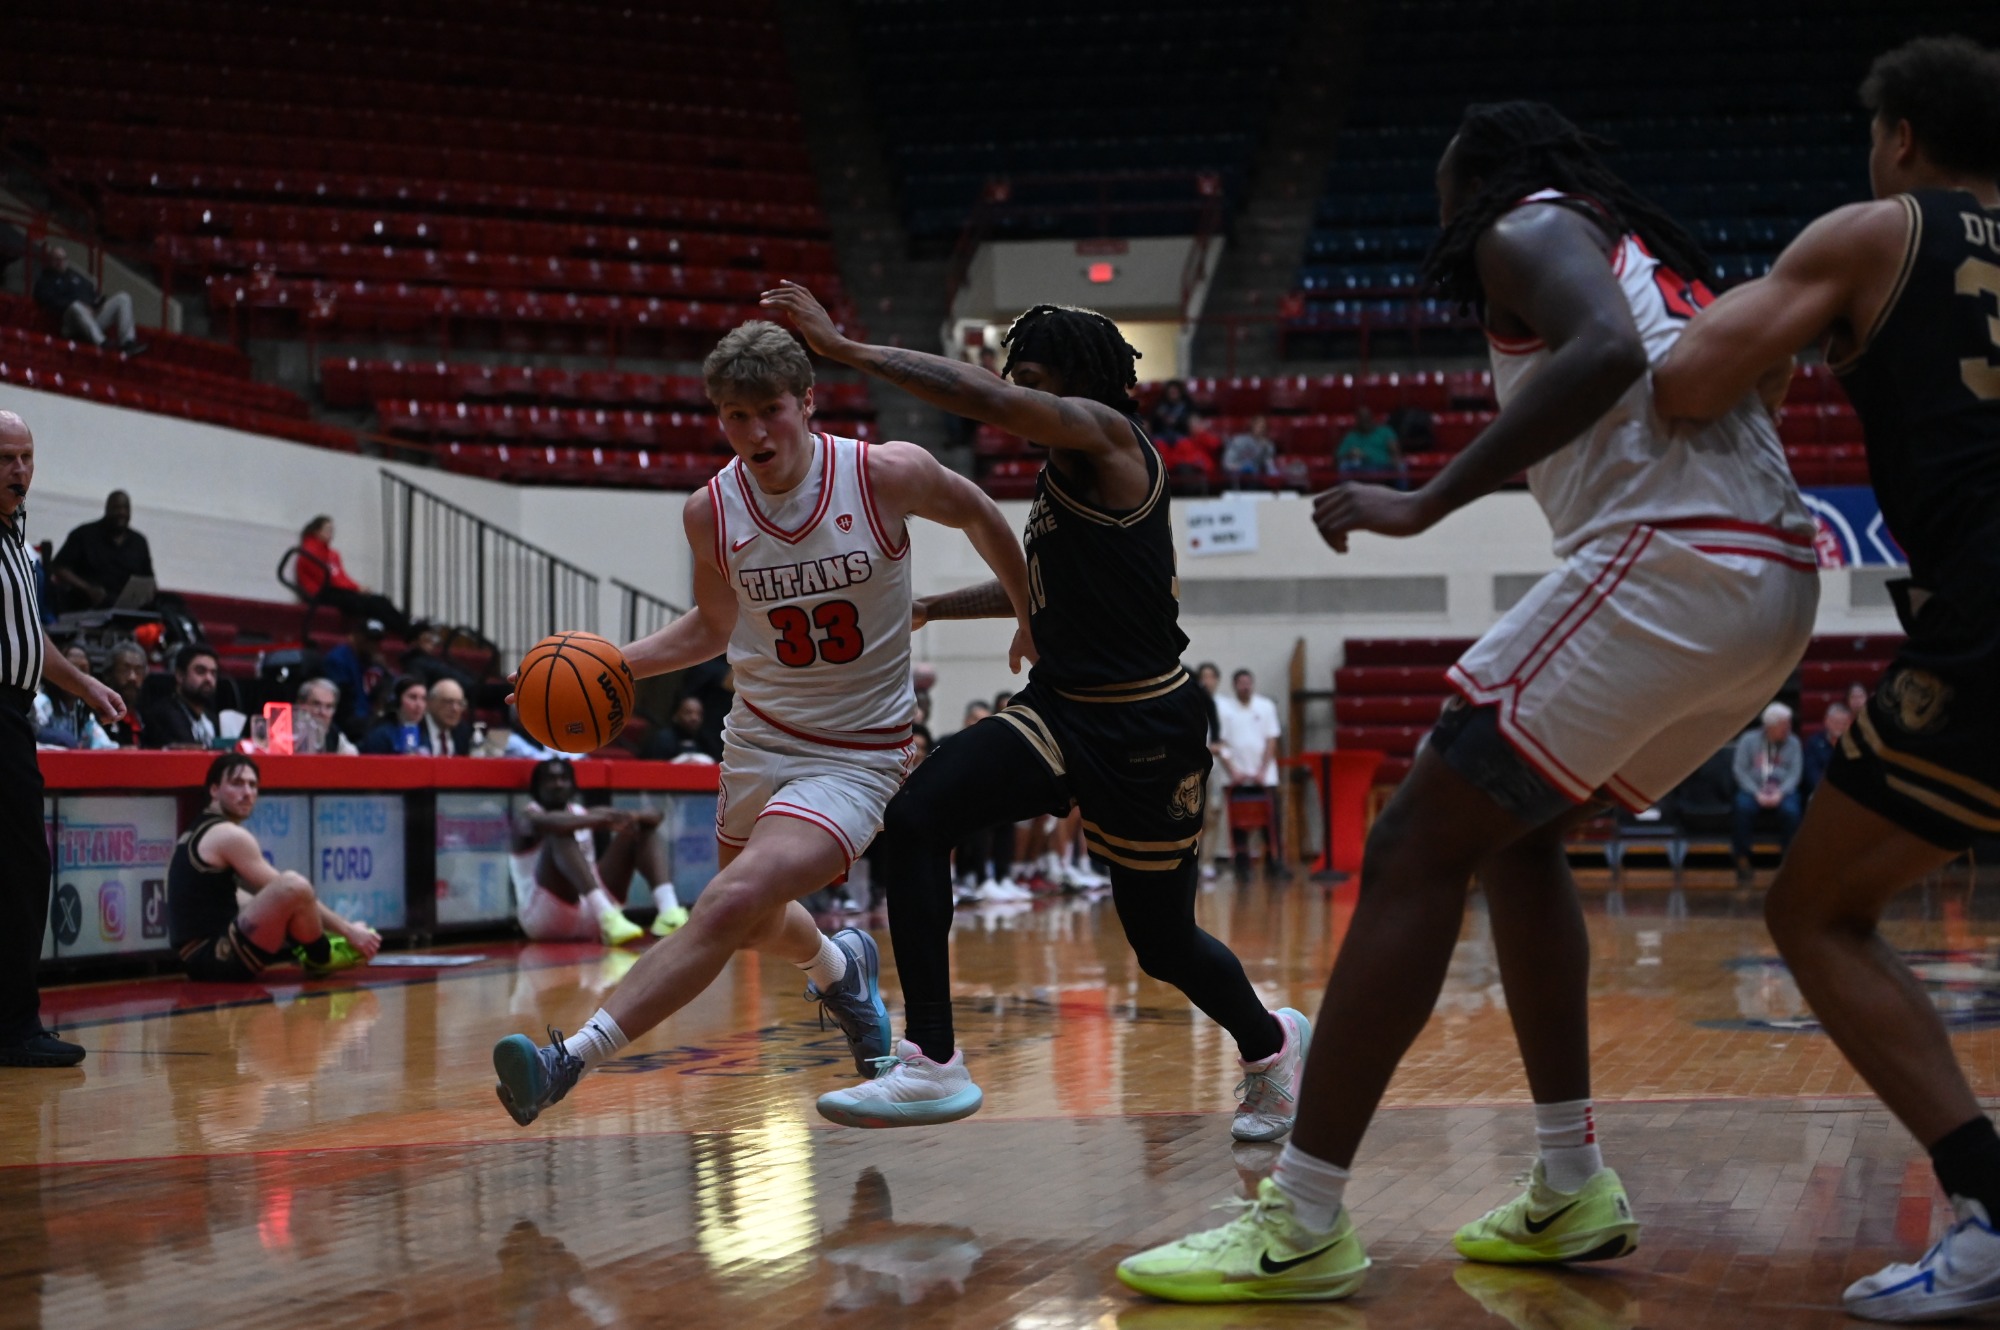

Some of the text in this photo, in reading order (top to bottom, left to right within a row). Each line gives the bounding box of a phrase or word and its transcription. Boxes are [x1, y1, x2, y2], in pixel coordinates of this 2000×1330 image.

[739, 551, 872, 601] TITANS
[767, 599, 864, 667] 33
[319, 803, 387, 834] HENRY
[322, 847, 373, 882] FORD
